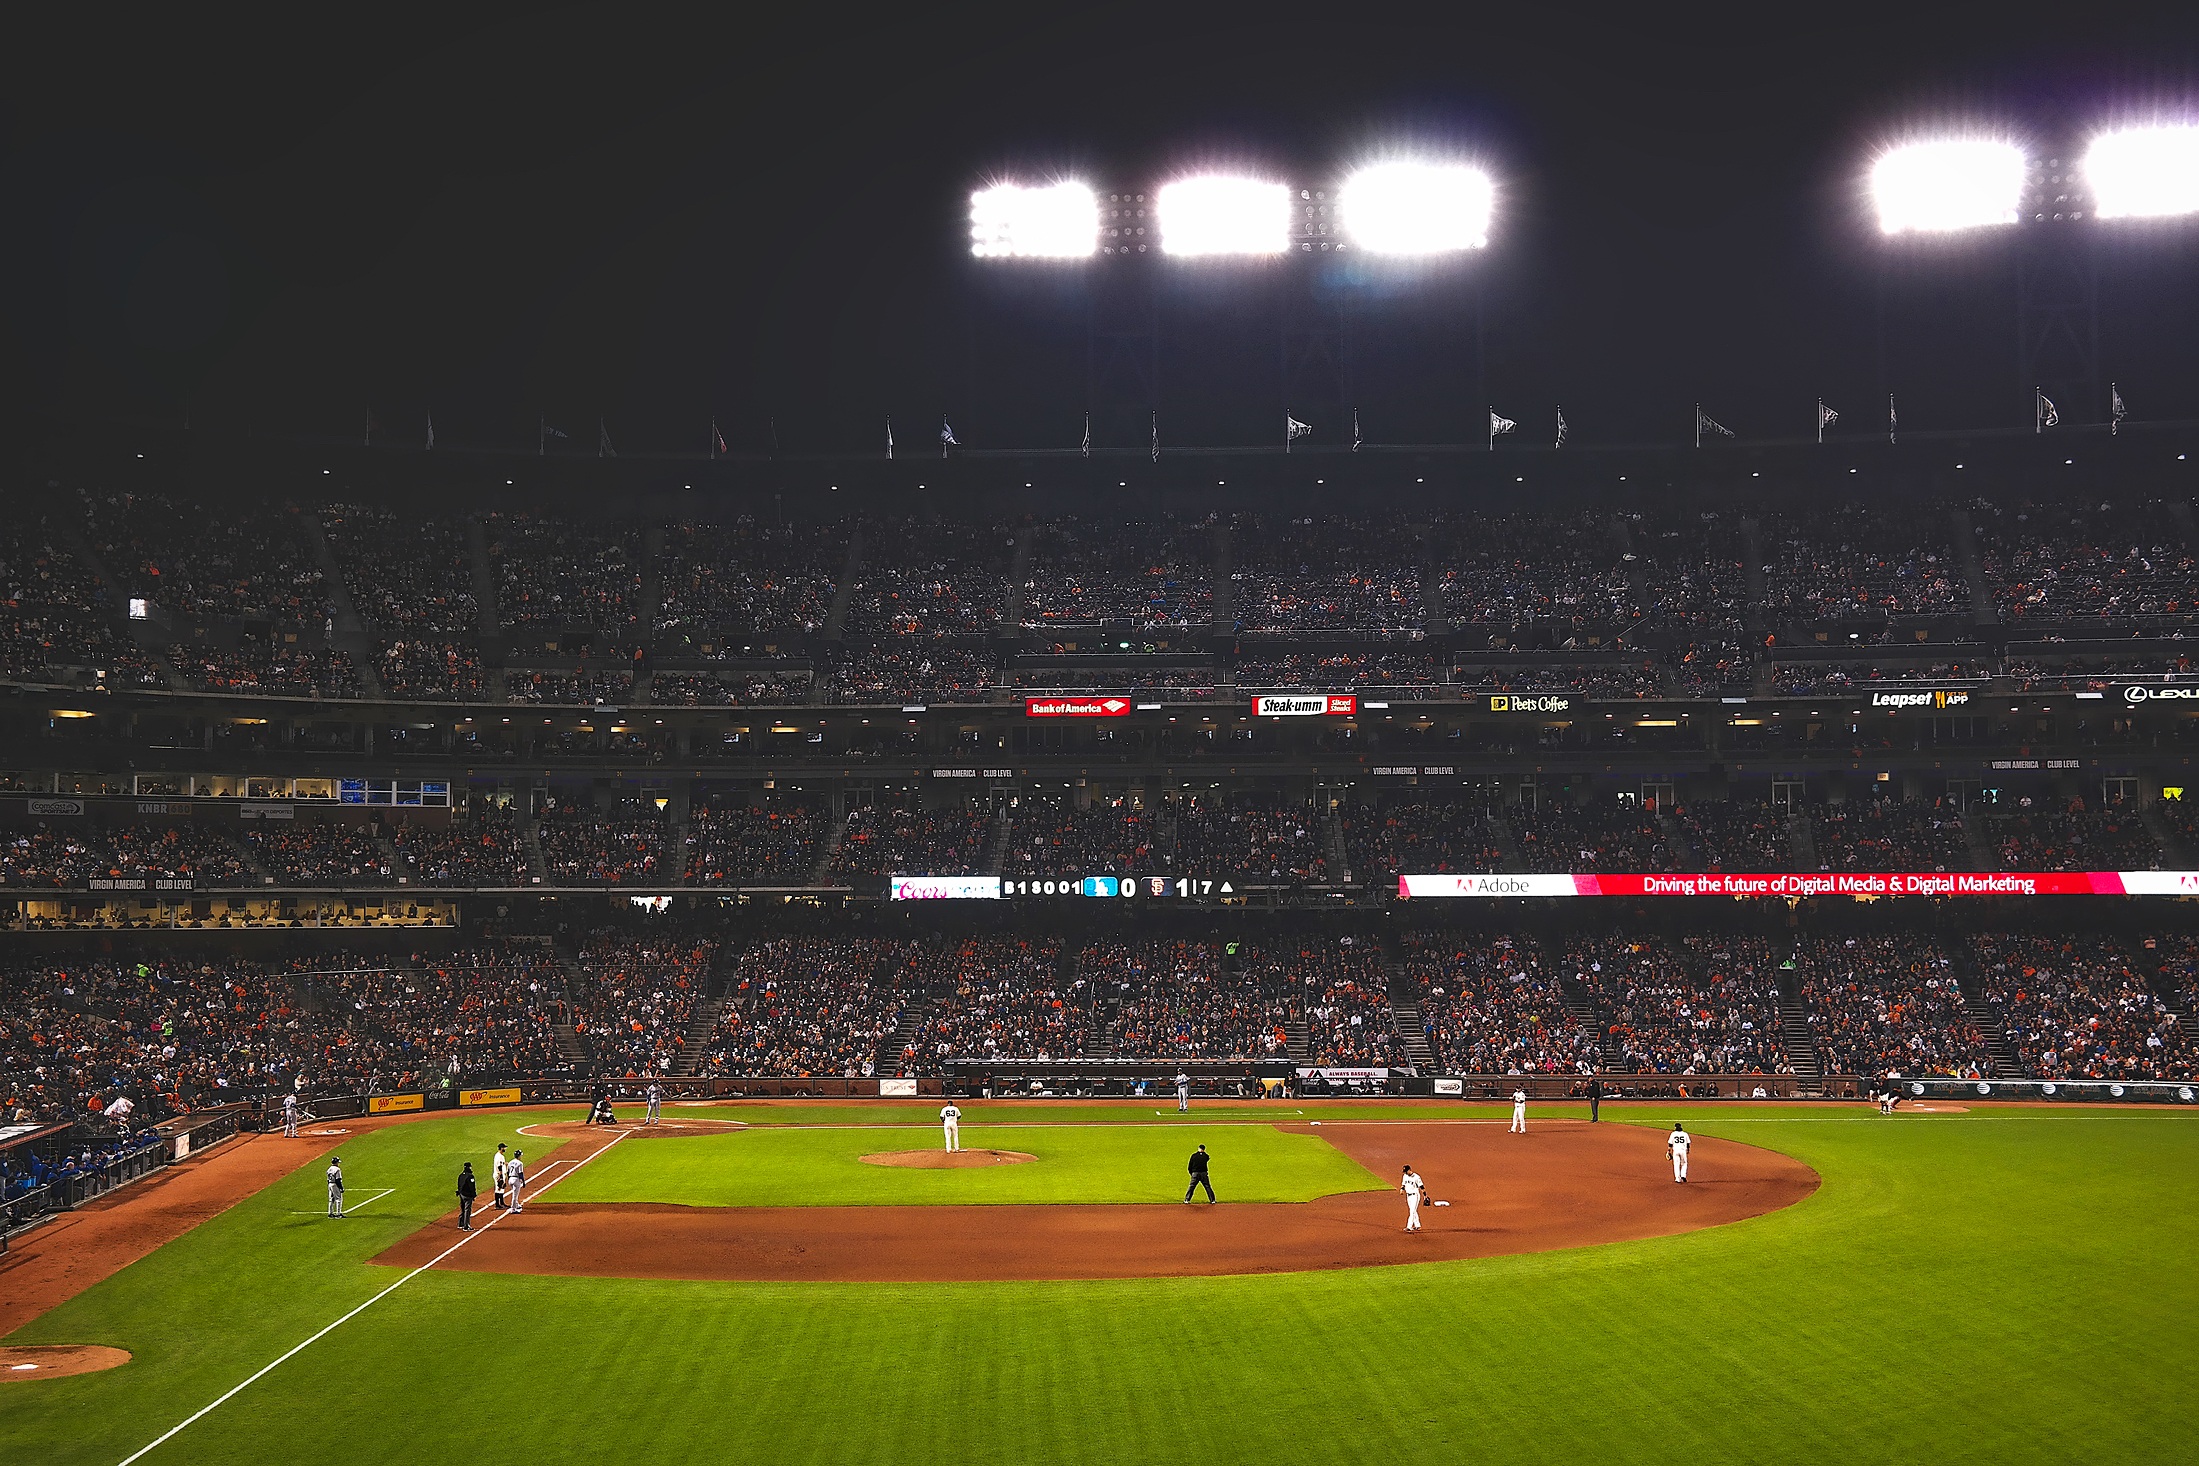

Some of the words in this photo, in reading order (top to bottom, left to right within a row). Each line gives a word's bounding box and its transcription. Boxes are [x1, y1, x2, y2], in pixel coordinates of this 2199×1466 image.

[1263, 698, 1323, 712] Steak-umm
[1538, 696, 1569, 713] Coffee
[1872, 692, 1933, 708] Leapset
[1946, 696, 1969, 704] APP
[1032, 704, 1055, 713] Bank
[1056, 704, 1065, 713] of
[1065, 704, 1102, 713] America
[1373, 767, 1392, 775] VIRGIN
[1392, 767, 1417, 775] AMERICA
[1424, 767, 1438, 775] CLUB
[1439, 766, 1454, 775] LEVEL
[1992, 761, 2011, 769] VIRGIN
[2012, 761, 2039, 769] AMERICA
[2047, 760, 2062, 769] CLUB
[2063, 760, 2080, 768] LEVEL
[932, 769, 951, 778] VIRGIN
[952, 769, 976, 778] AMERICA
[983, 769, 997, 778] CLUB
[998, 769, 1012, 778] LEVEL
[137, 803, 168, 814] KNBR
[170, 804, 190, 813] 680
[89, 879, 114, 890] VIRGIN
[114, 879, 146, 890] AMERICA
[155, 879, 174, 890] CLUB
[174, 879, 192, 890] LEVEL
[900, 881, 947, 899] Coors
[1201, 881, 1212, 894] 7
[1477, 878, 1530, 892] Adobe
[1643, 876, 1695, 895] Driving
[1697, 876, 1722, 892] the
[1724, 875, 1768, 893] future
[1770, 875, 1788, 892] of
[1788, 876, 1835, 895] Digital
[1838, 876, 1886, 892] Media
[1889, 876, 1903, 892] &
[1907, 875, 1954, 895] Digital
[1958, 875, 2036, 895] Marketing
